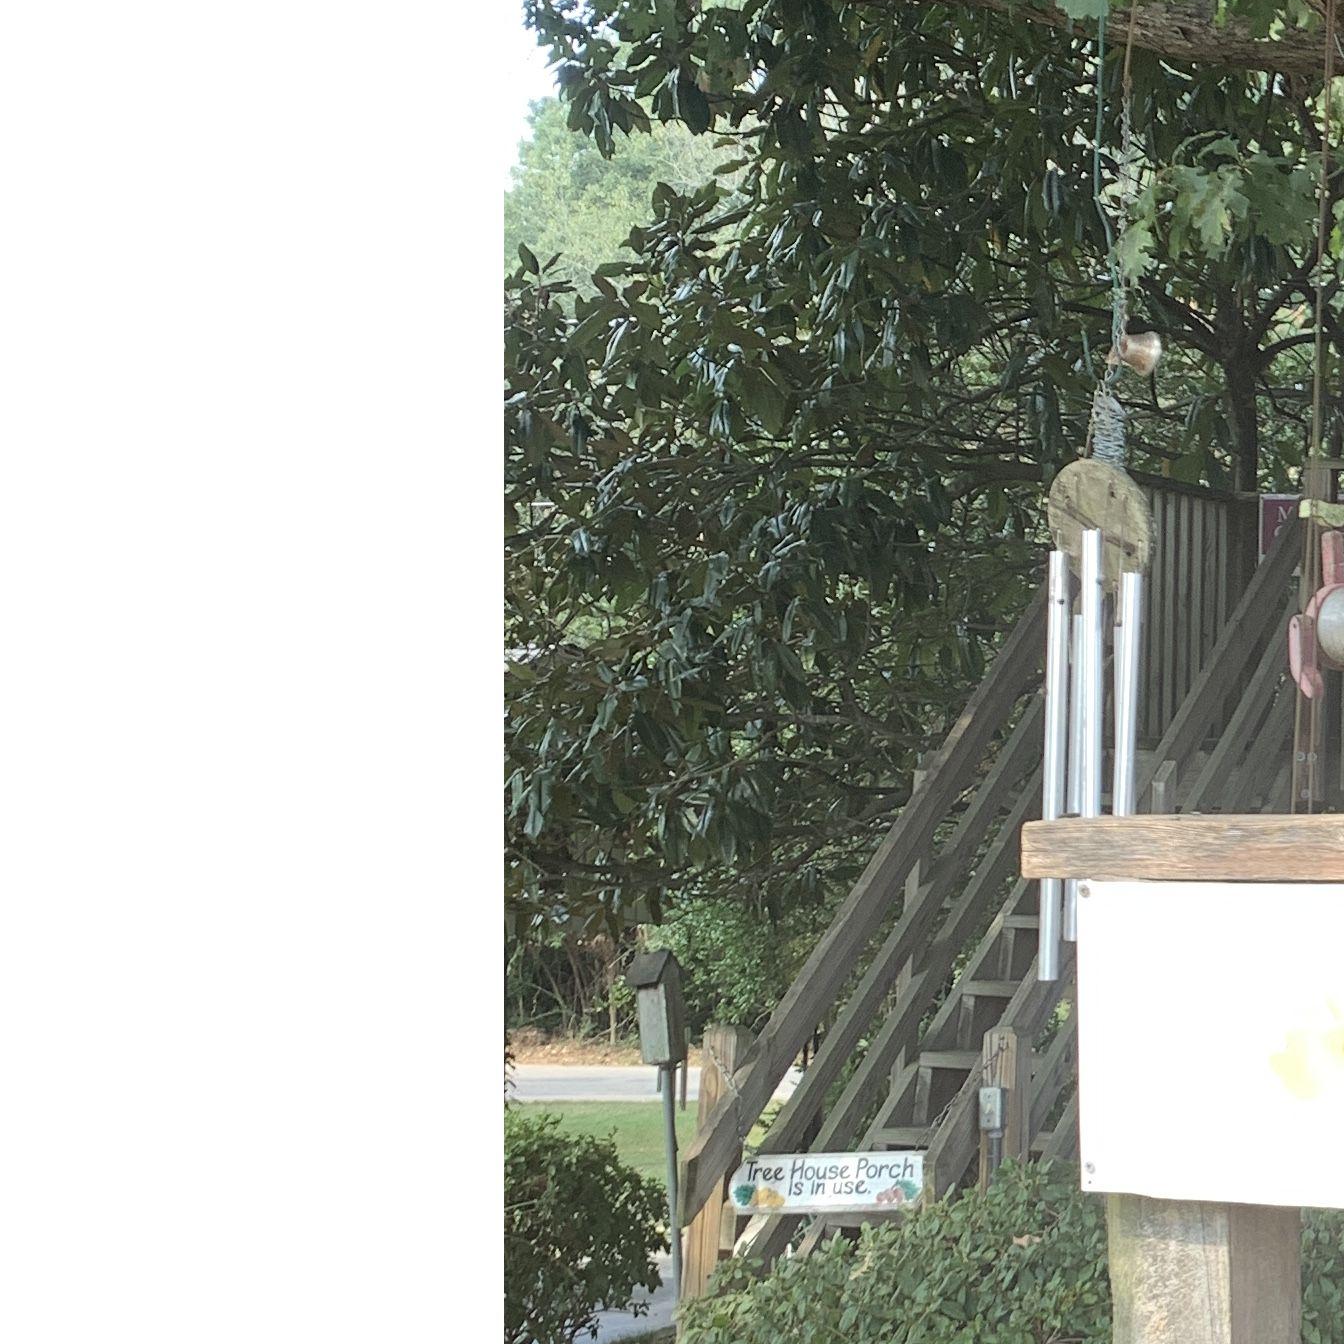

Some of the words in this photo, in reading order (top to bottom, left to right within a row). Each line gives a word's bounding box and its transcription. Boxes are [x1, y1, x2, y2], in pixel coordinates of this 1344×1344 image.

[747, 1161, 784, 1182] Tree
[790, 1158, 850, 1181] House
[855, 1157, 914, 1179] Porch
